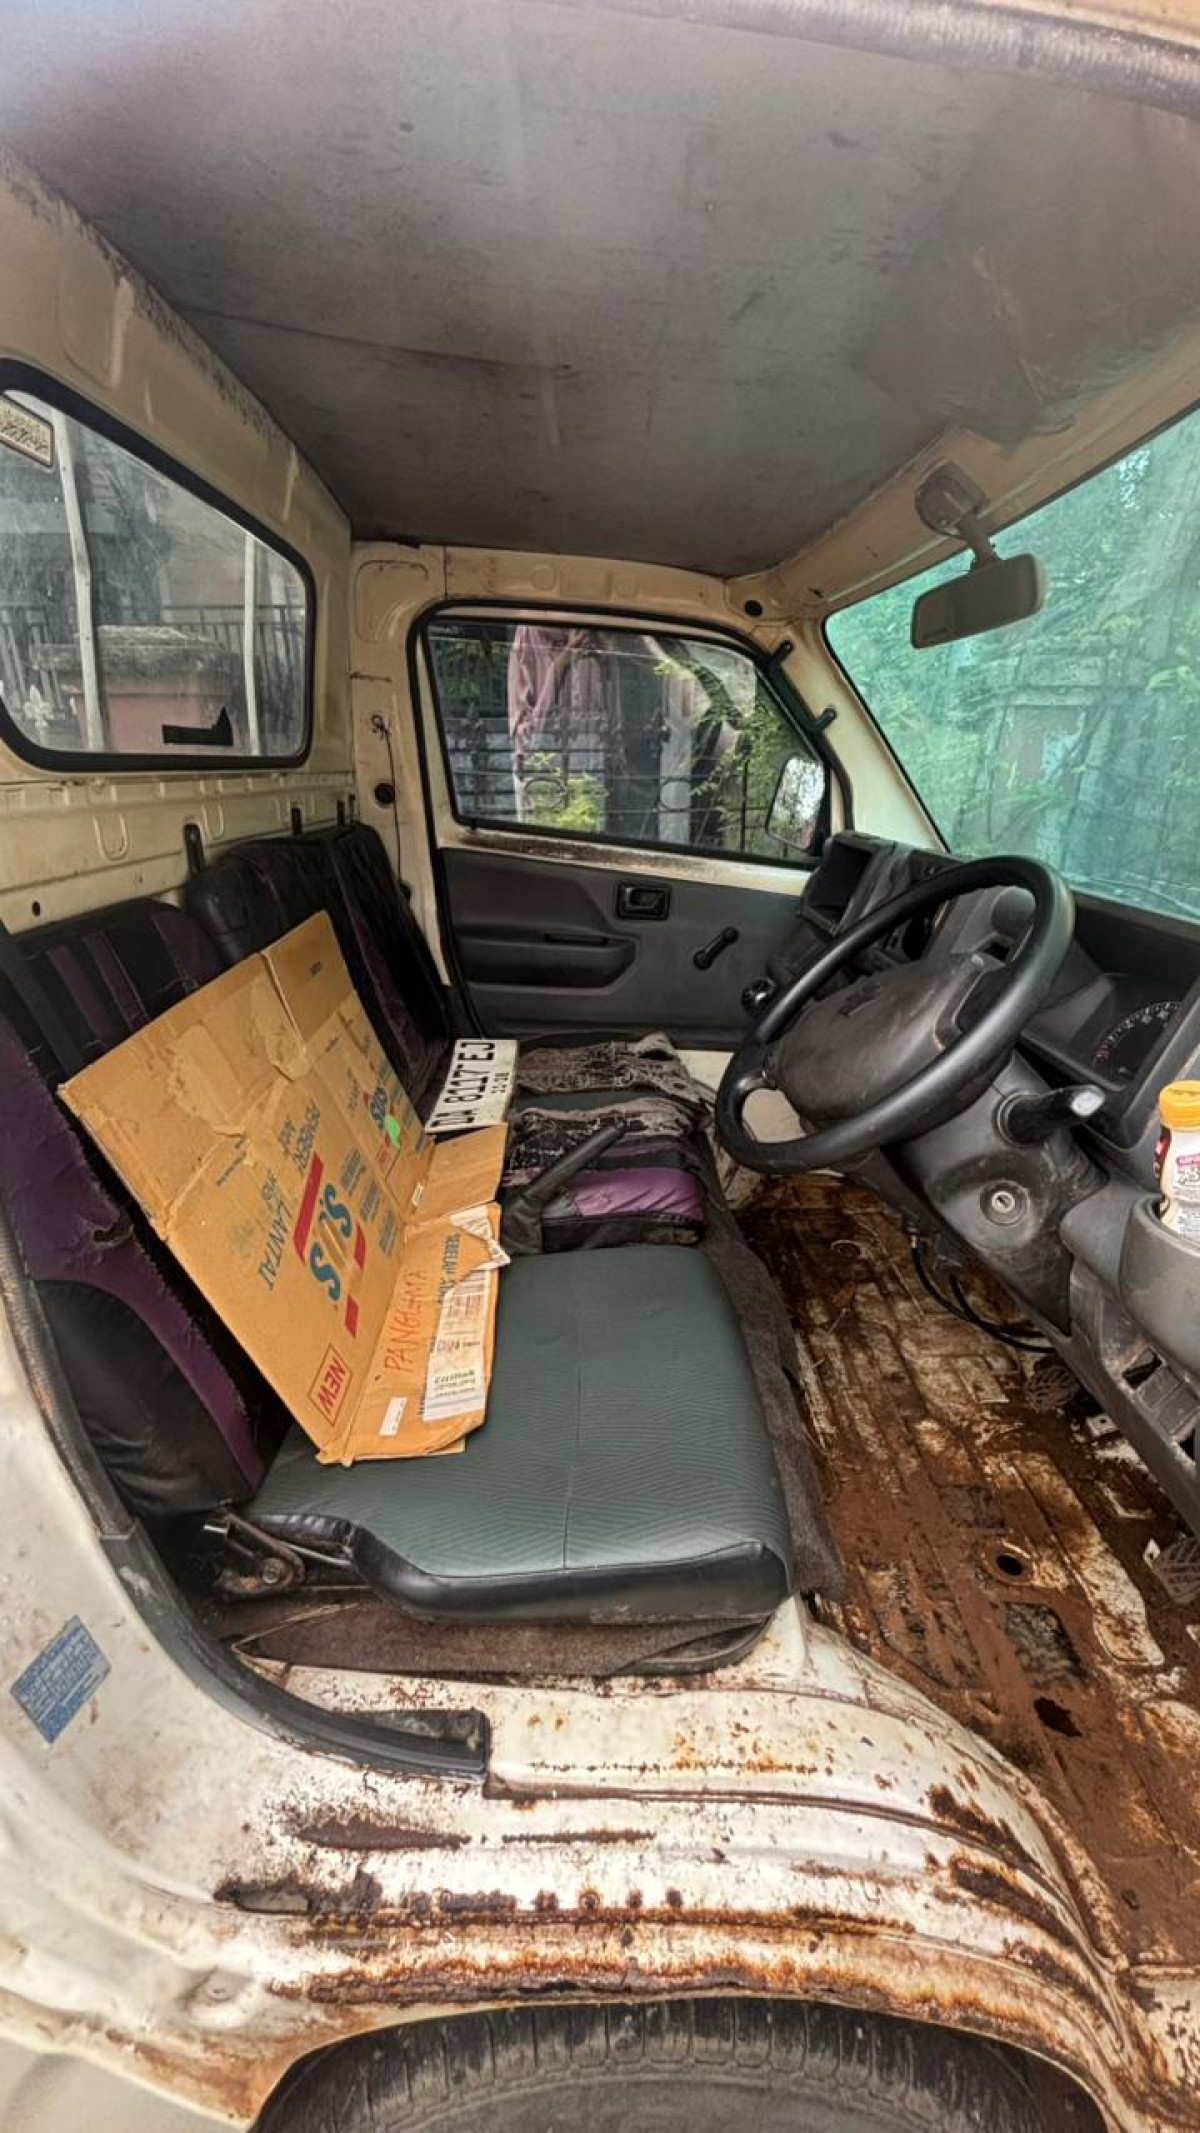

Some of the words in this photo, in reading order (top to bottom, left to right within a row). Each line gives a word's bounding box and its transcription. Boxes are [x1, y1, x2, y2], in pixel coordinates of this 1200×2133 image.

[458, 1042, 496, 1061] EJ
[258, 1201, 293, 1291] LANTAI
[318, 1357, 345, 1415] NEW
